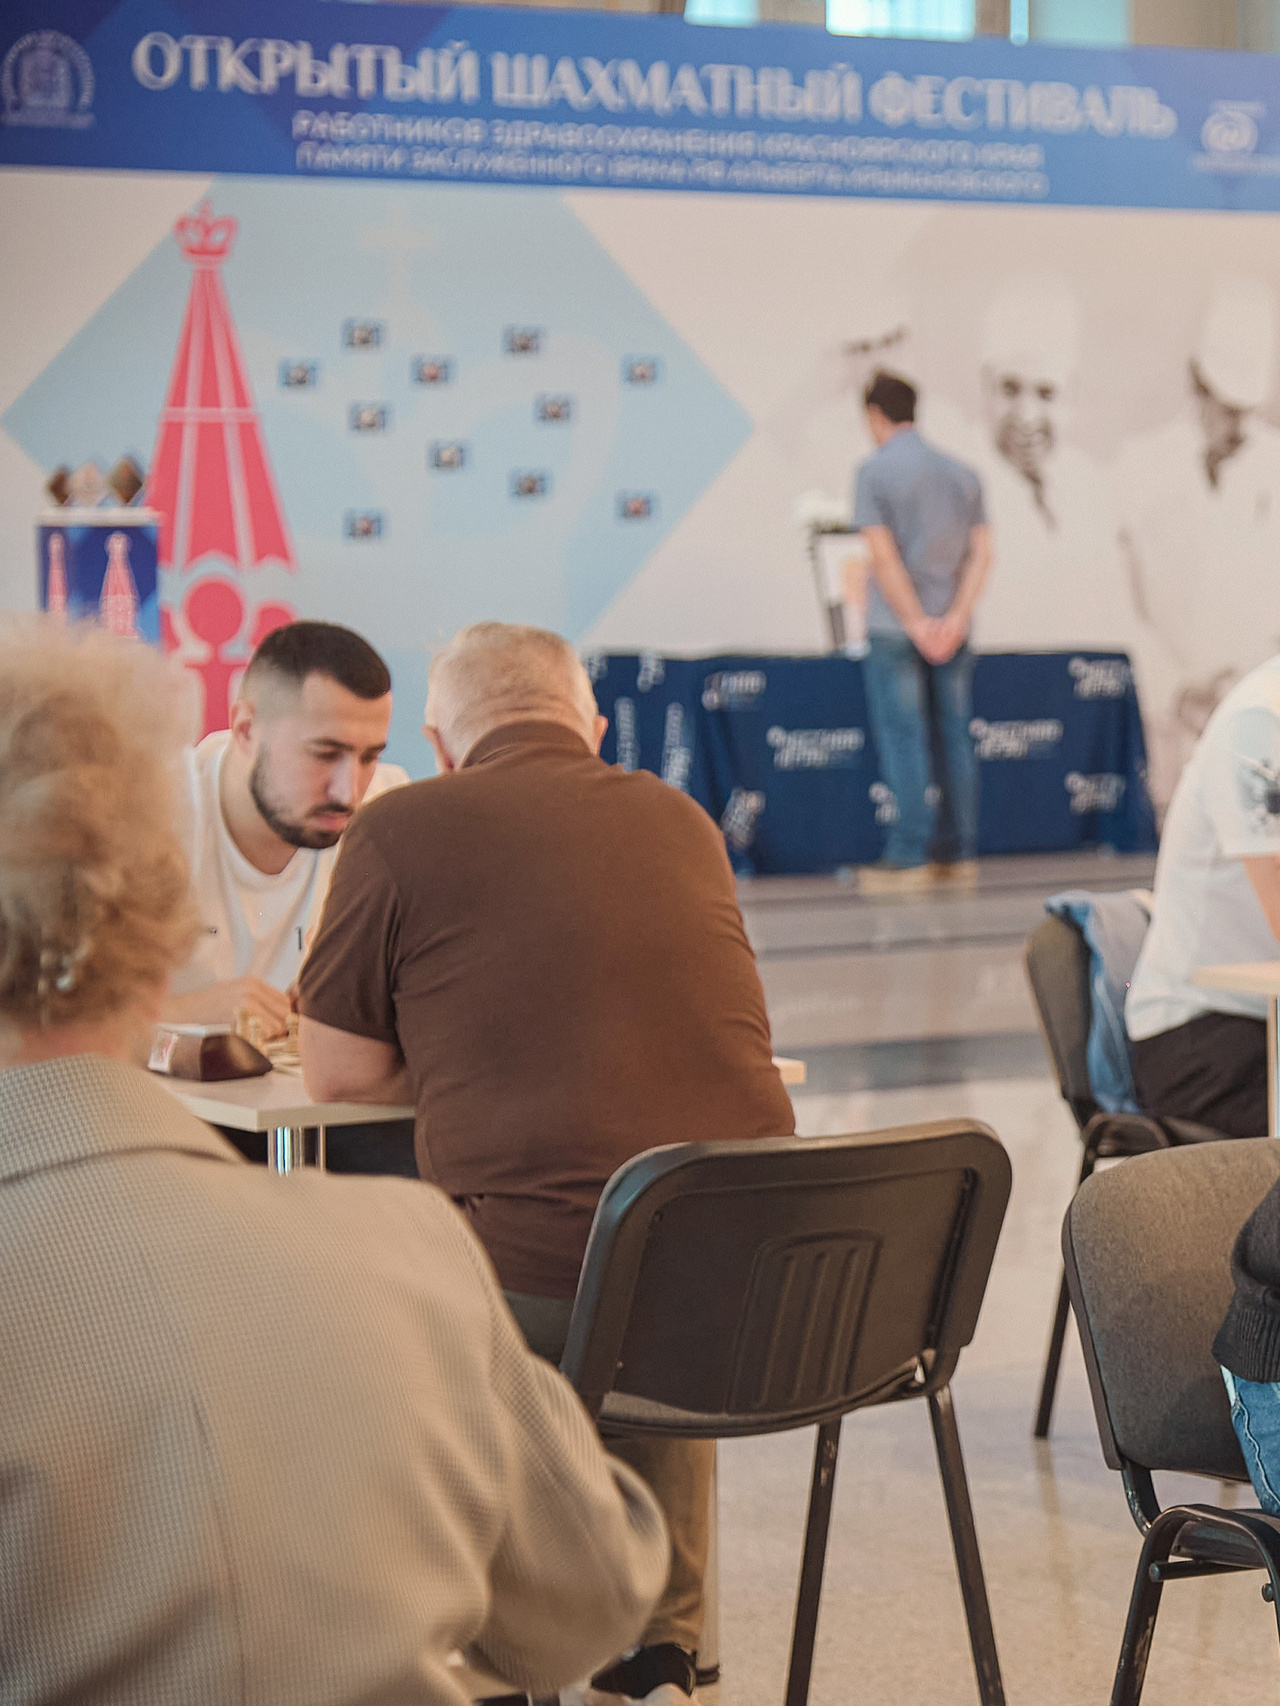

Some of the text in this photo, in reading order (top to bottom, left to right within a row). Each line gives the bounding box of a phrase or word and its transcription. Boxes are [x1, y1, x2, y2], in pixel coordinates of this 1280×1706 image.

[133, 31, 481, 103] ОТКРЫТЫЙ
[492, 53, 862, 122] ШАХМАТНЫЙ
[870, 72, 1177, 138] ФЕСТИВАЛЬ
